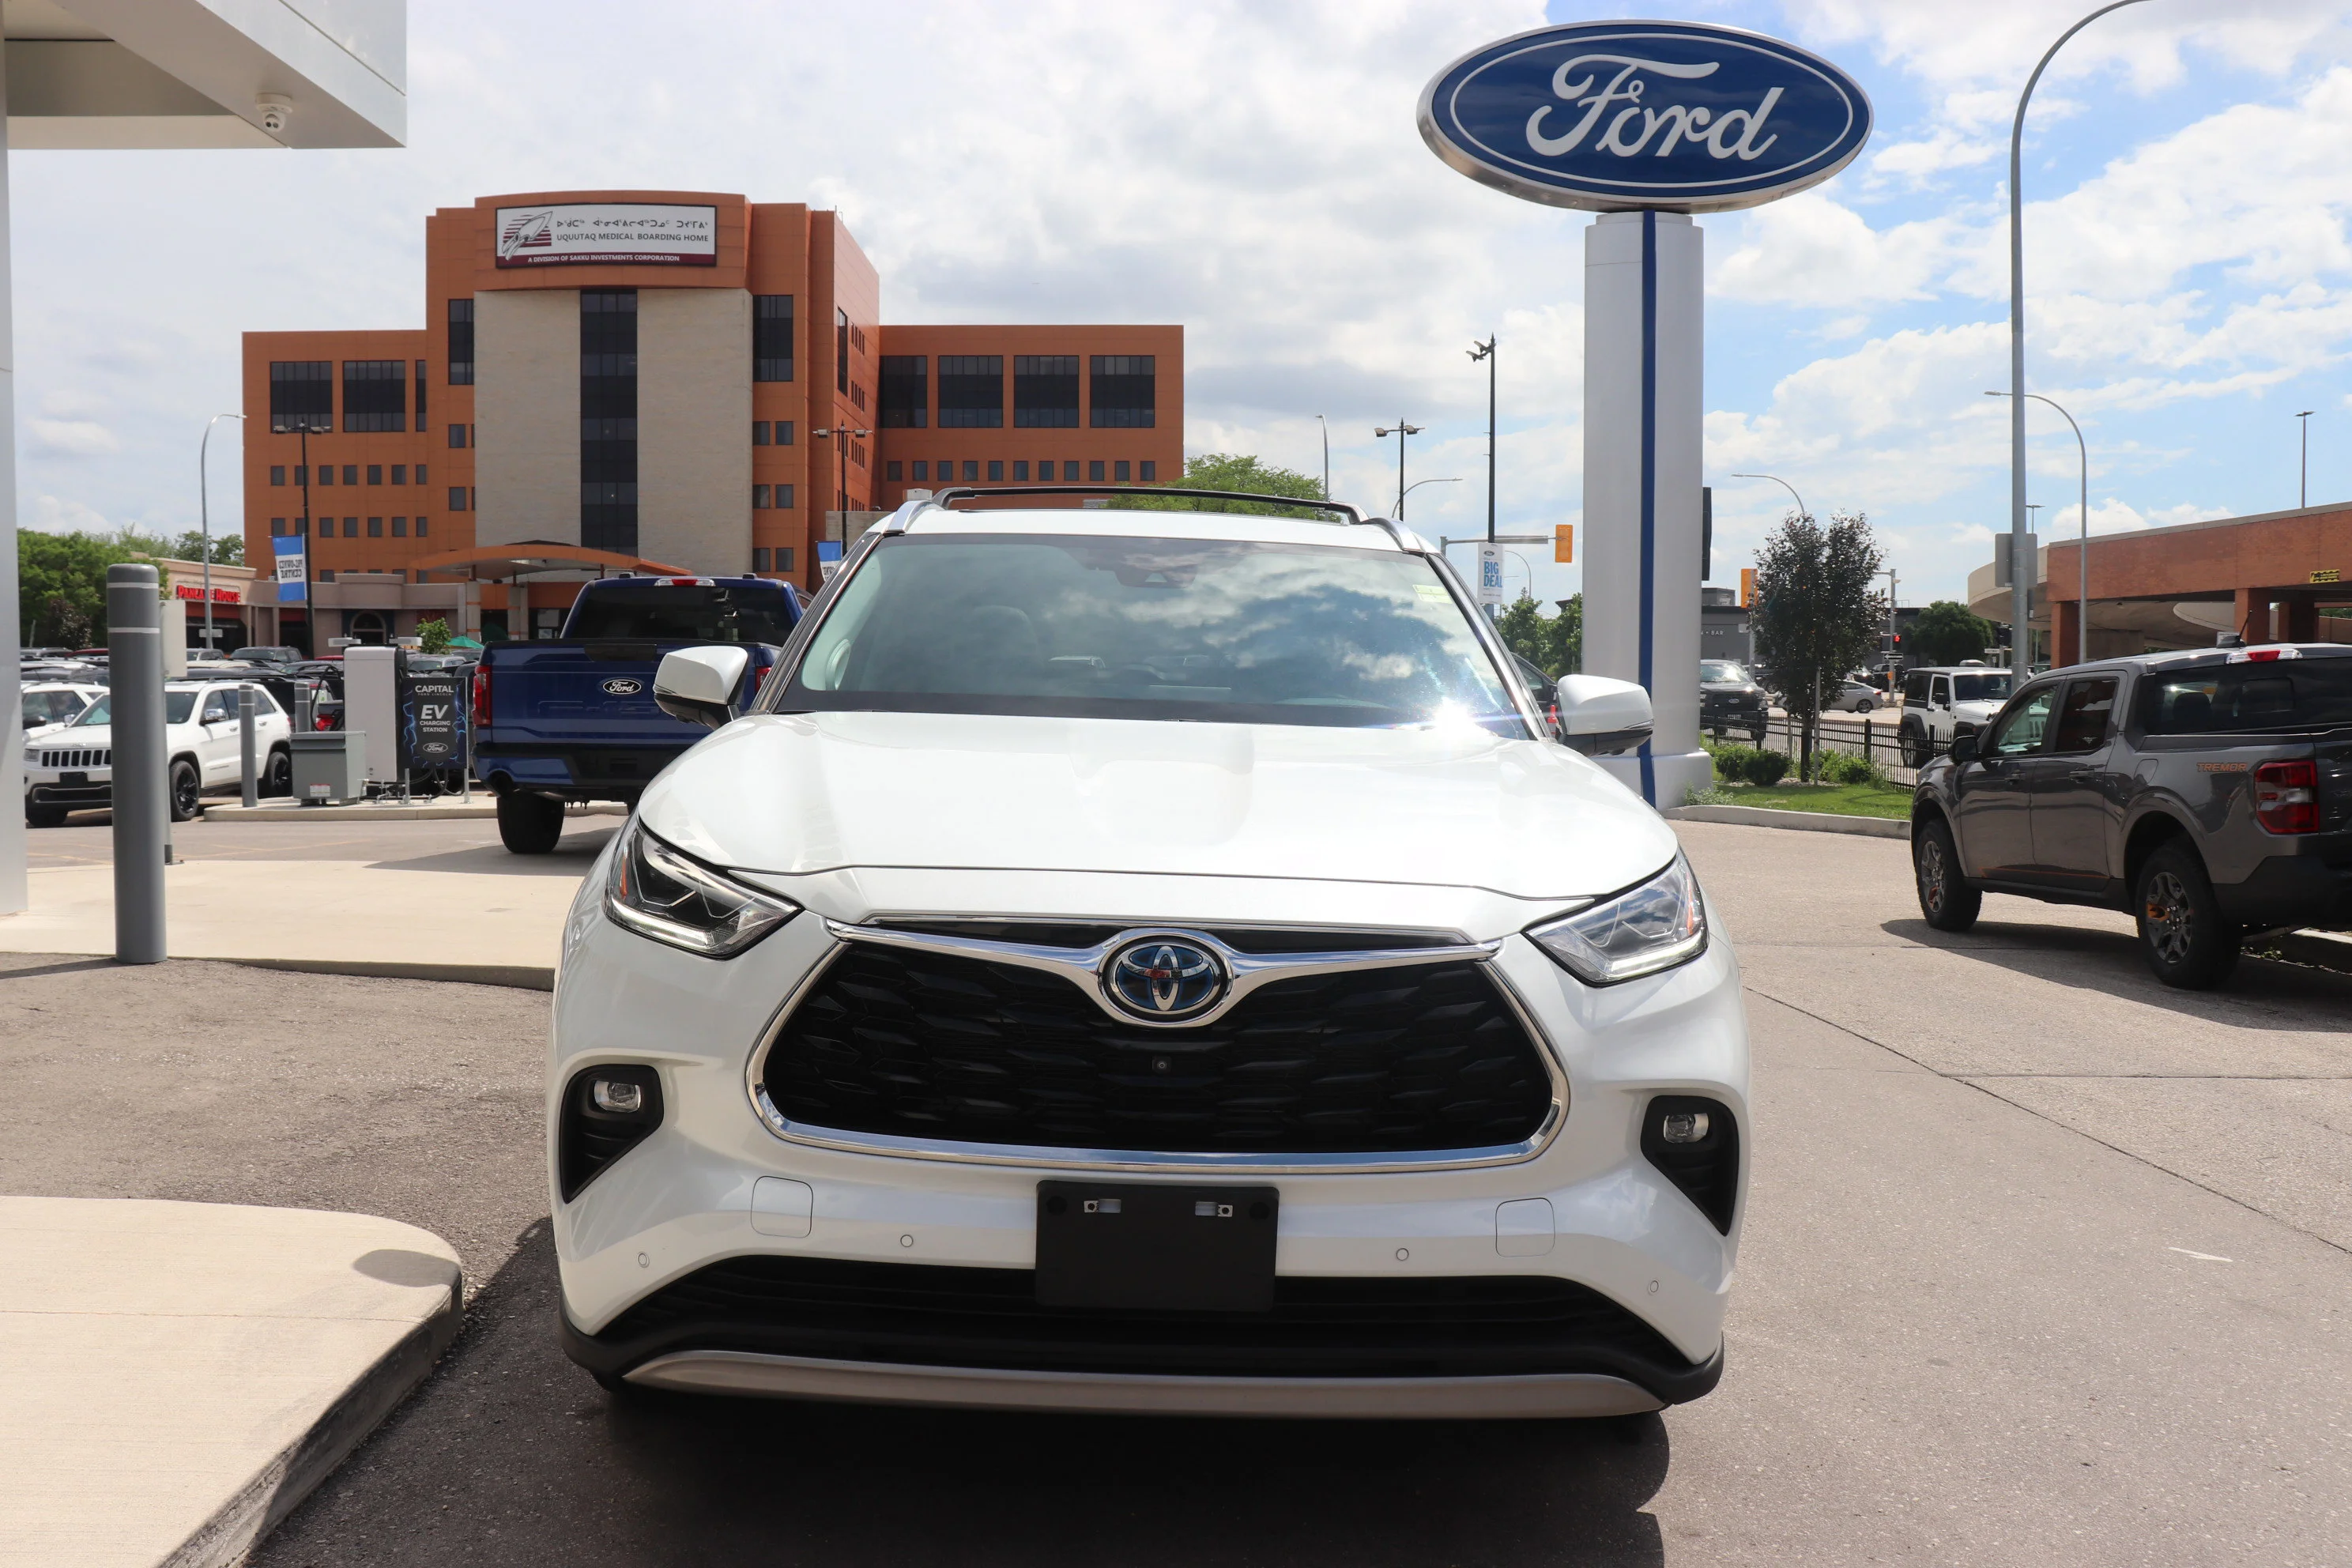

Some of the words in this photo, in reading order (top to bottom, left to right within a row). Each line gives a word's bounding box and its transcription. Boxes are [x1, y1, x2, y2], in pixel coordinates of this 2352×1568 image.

[1525, 53, 1785, 160] Ford
[556, 233, 597, 242] UQUUTAQ
[1483, 560, 1499, 575] BIG
[1483, 575, 1503, 588] DEAL
[176, 585, 215, 600] PANCAE
[214, 588, 241, 602] HOUSE
[609, 680, 635, 692] Ford
[420, 704, 449, 719] EV
[2196, 762, 2248, 773] TREMOR
